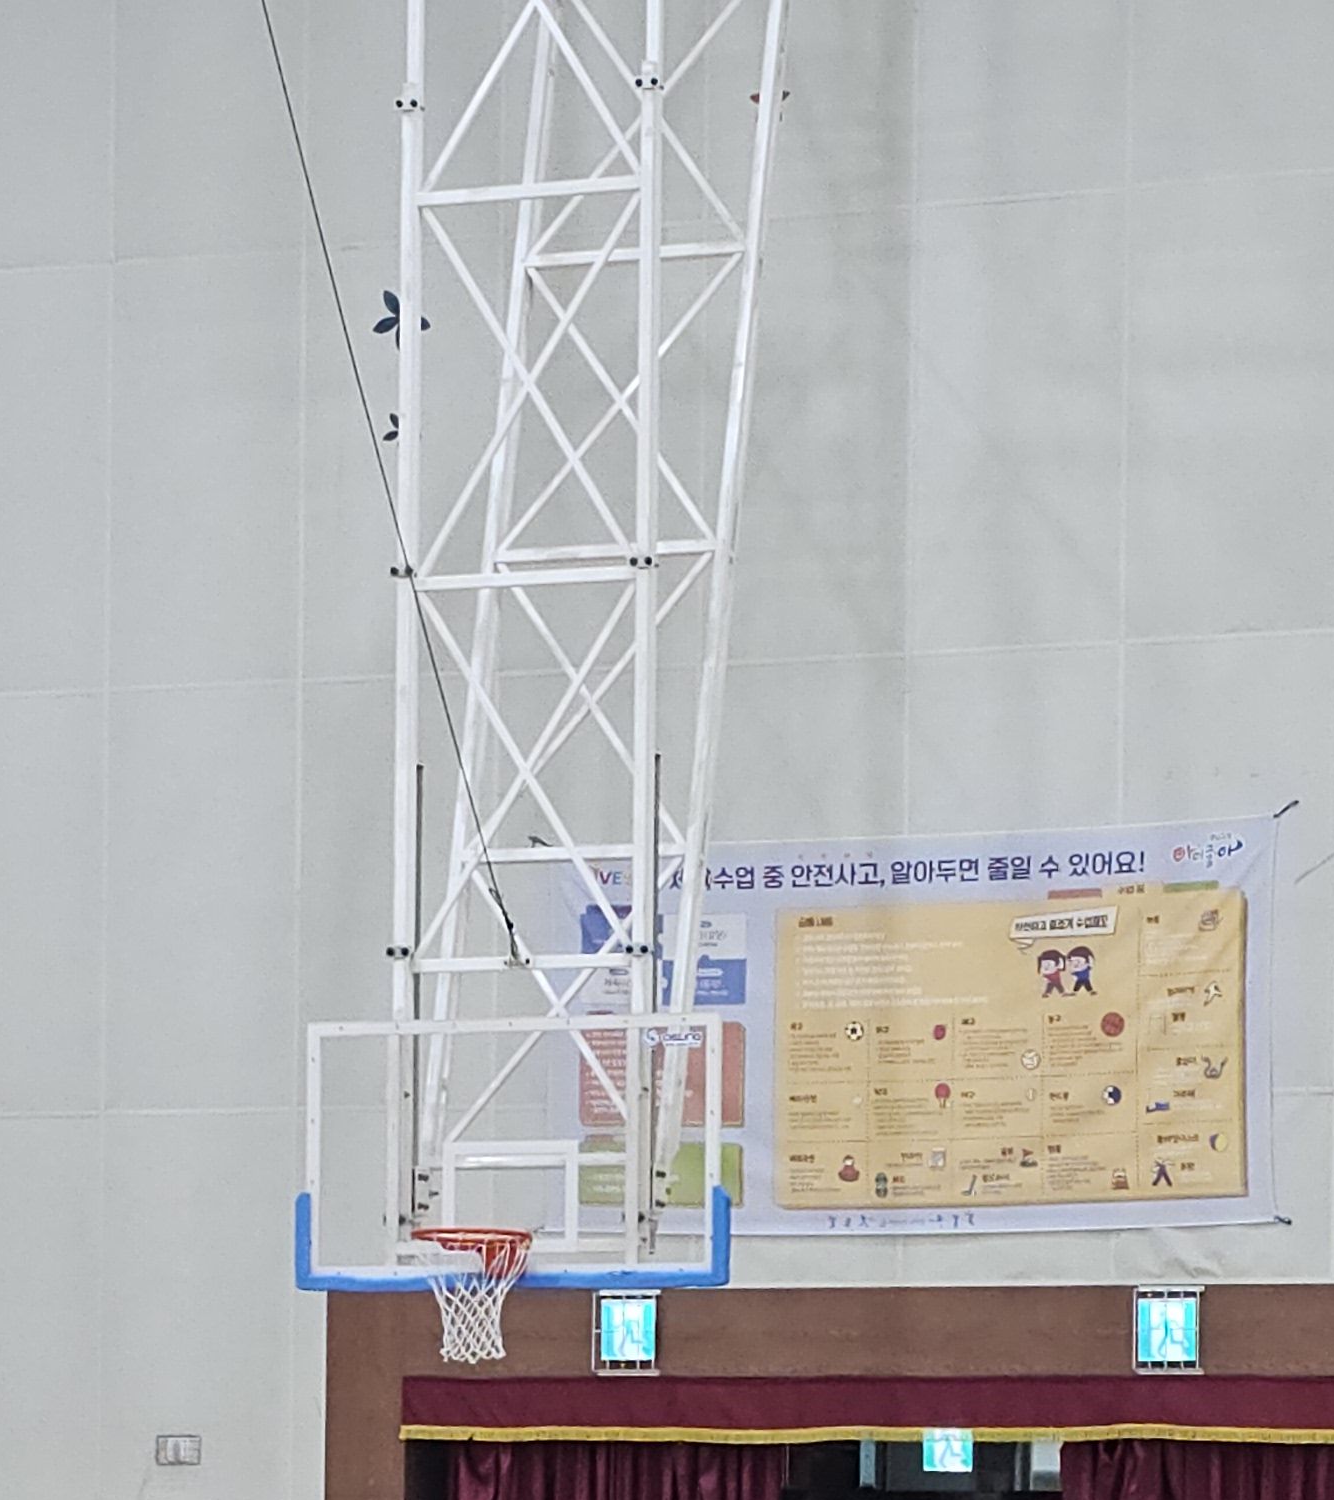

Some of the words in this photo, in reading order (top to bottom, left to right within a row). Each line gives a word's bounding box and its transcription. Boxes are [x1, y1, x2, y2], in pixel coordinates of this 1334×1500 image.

[763, 865, 783, 889] 중
[791, 861, 884, 888] 안전사고,
[890, 857, 979, 886] 알아두면
[987, 855, 1031, 882] 줄일
[1039, 855, 1059, 879] 수
[1068, 850, 1145, 877] 있어요!
